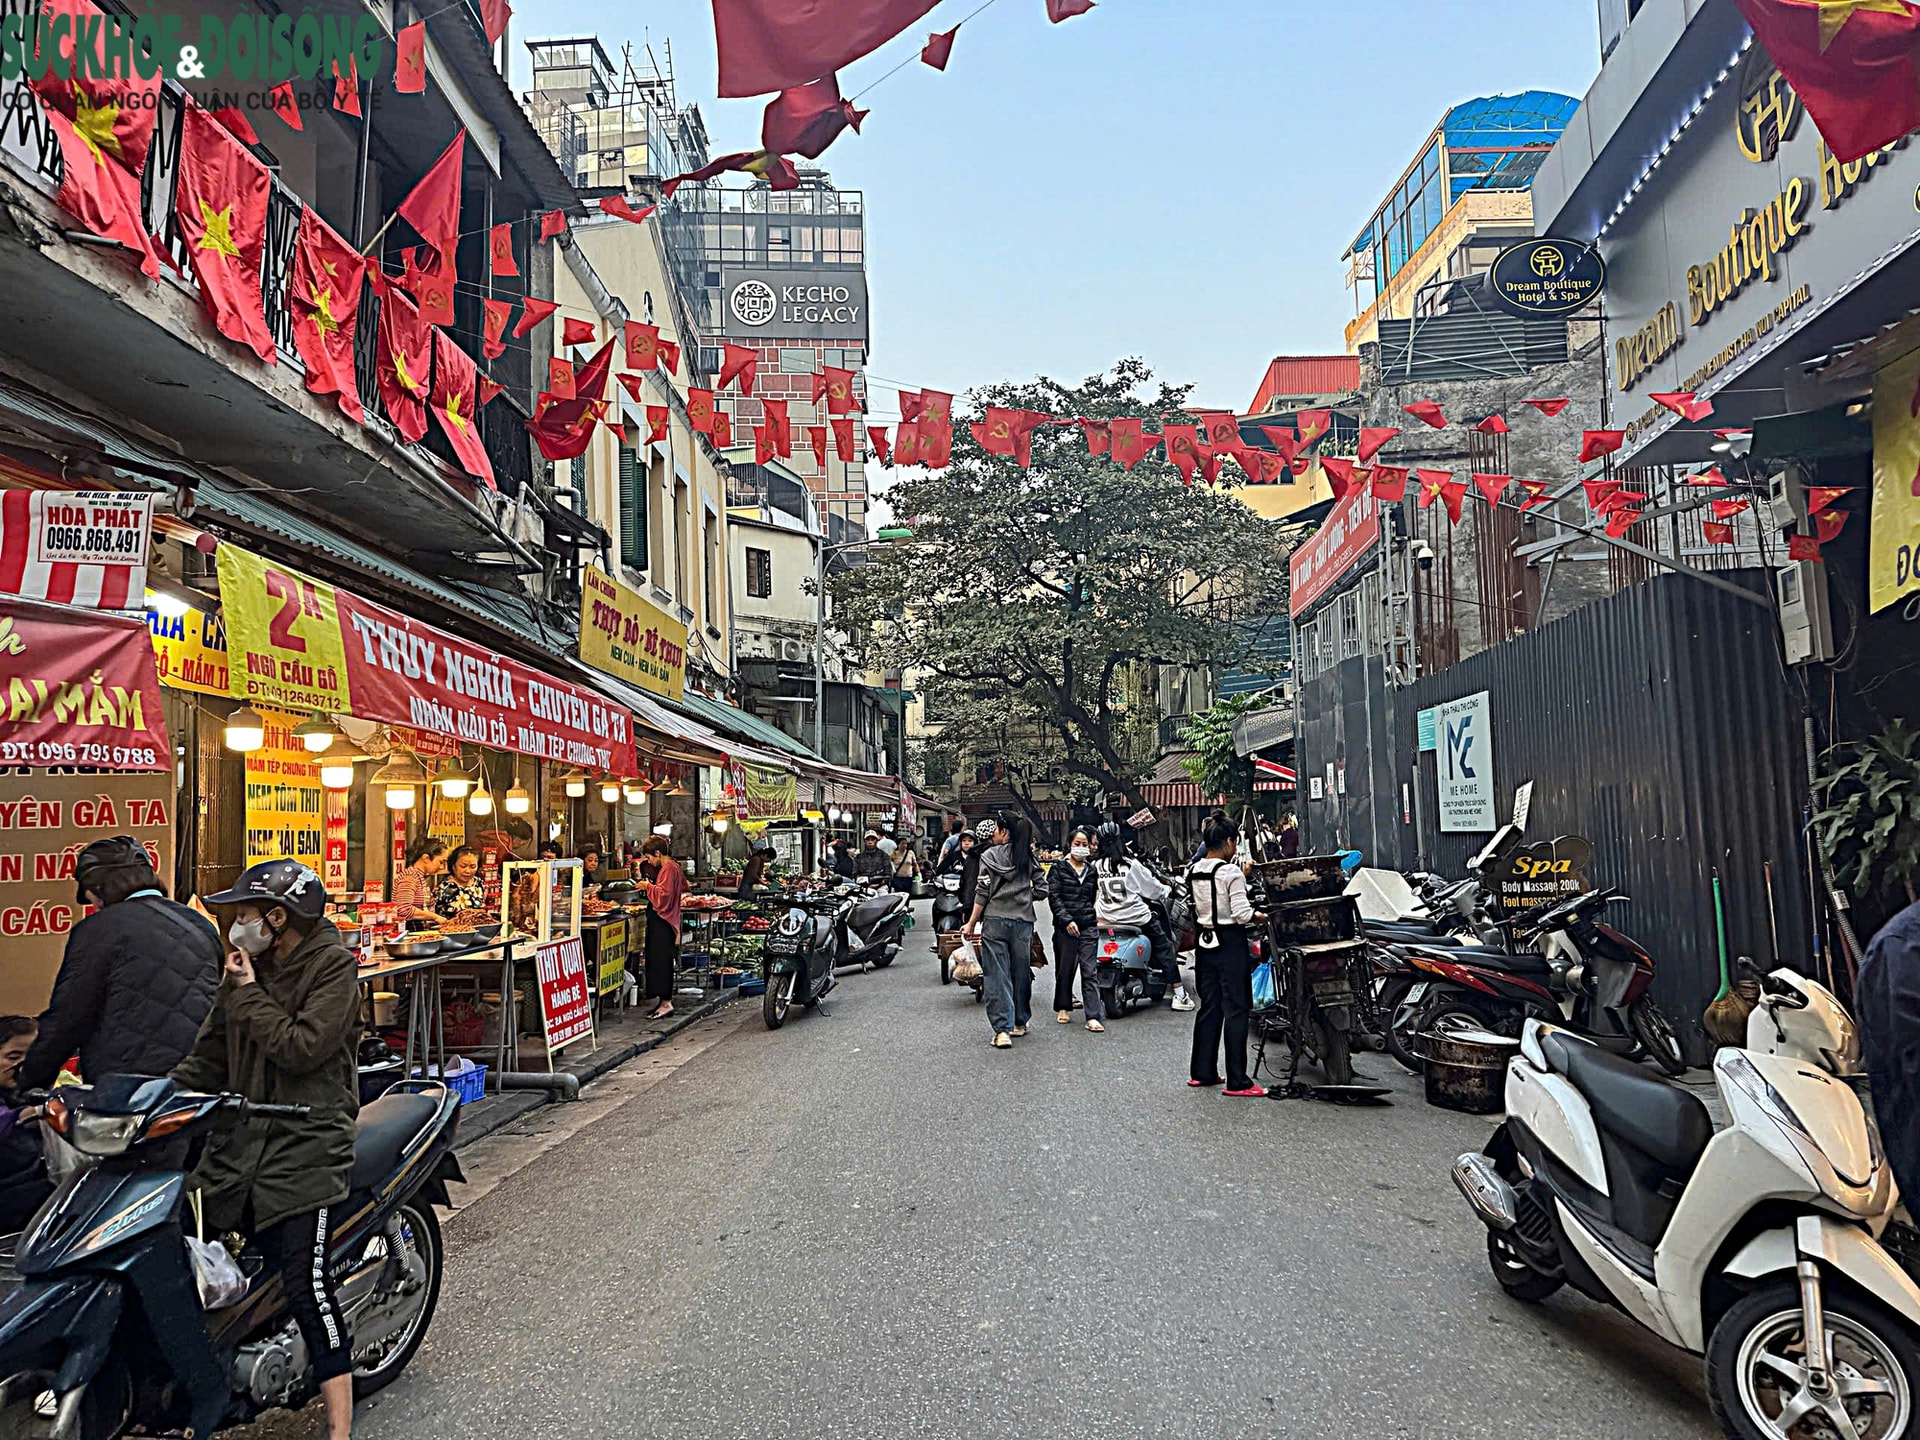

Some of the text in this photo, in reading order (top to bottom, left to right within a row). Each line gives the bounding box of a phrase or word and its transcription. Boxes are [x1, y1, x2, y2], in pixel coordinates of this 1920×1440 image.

[782, 286, 850, 303] KECHO
[1506, 279, 1592, 292] Dream Boutique
[1518, 291, 1580, 302] Hotel & Spa
[1615, 300, 1678, 391] Dream
[1688, 177, 1803, 326] Boutique
[782, 306, 859, 323] LEGACY
[1773, 284, 1810, 324] CAPITAL
[47, 504, 143, 528] HÒA PHÁT
[46, 527, 140, 553] 0966.868.491
[264, 568, 324, 653] 2A
[592, 598, 622, 641] THỊT
[659, 637, 684, 670] THUI
[182, 653, 215, 687] MẮM
[280, 658, 313, 687] CẦU
[317, 664, 338, 691] GỖ
[610, 644, 622, 663] NEM
[623, 650, 635, 668] CUA
[638, 657, 649, 674] NEM
[351, 611, 627, 744] THỦY NGHĨA CHUYÊN GÀ TA
[409, 695, 456, 736] NHẬN
[458, 706, 488, 742] NẤU
[490, 713, 508, 747] CỖ
[517, 721, 545, 755] MẮM
[1, 742, 157, 765] ĐT: 096 795 6788
[247, 782, 321, 818] NEM TÔM THỊT
[1460, 783, 1478, 795] HOME
[0, 794, 168, 829] YÊN GÀ TA
[248, 830, 273, 856] NEM
[298, 823, 321, 855] SẢN
[34, 843, 80, 882] NẤ
[330, 864, 341, 877] 2A
[1511, 856, 1572, 879] Spa
[1502, 879, 1580, 894] Body Massage 200k
[1503, 896, 1520, 907] Foot
[1, 900, 72, 936] CÁC
[560, 940, 583, 981] QUAY
[551, 989, 571, 1009] HÀNG
